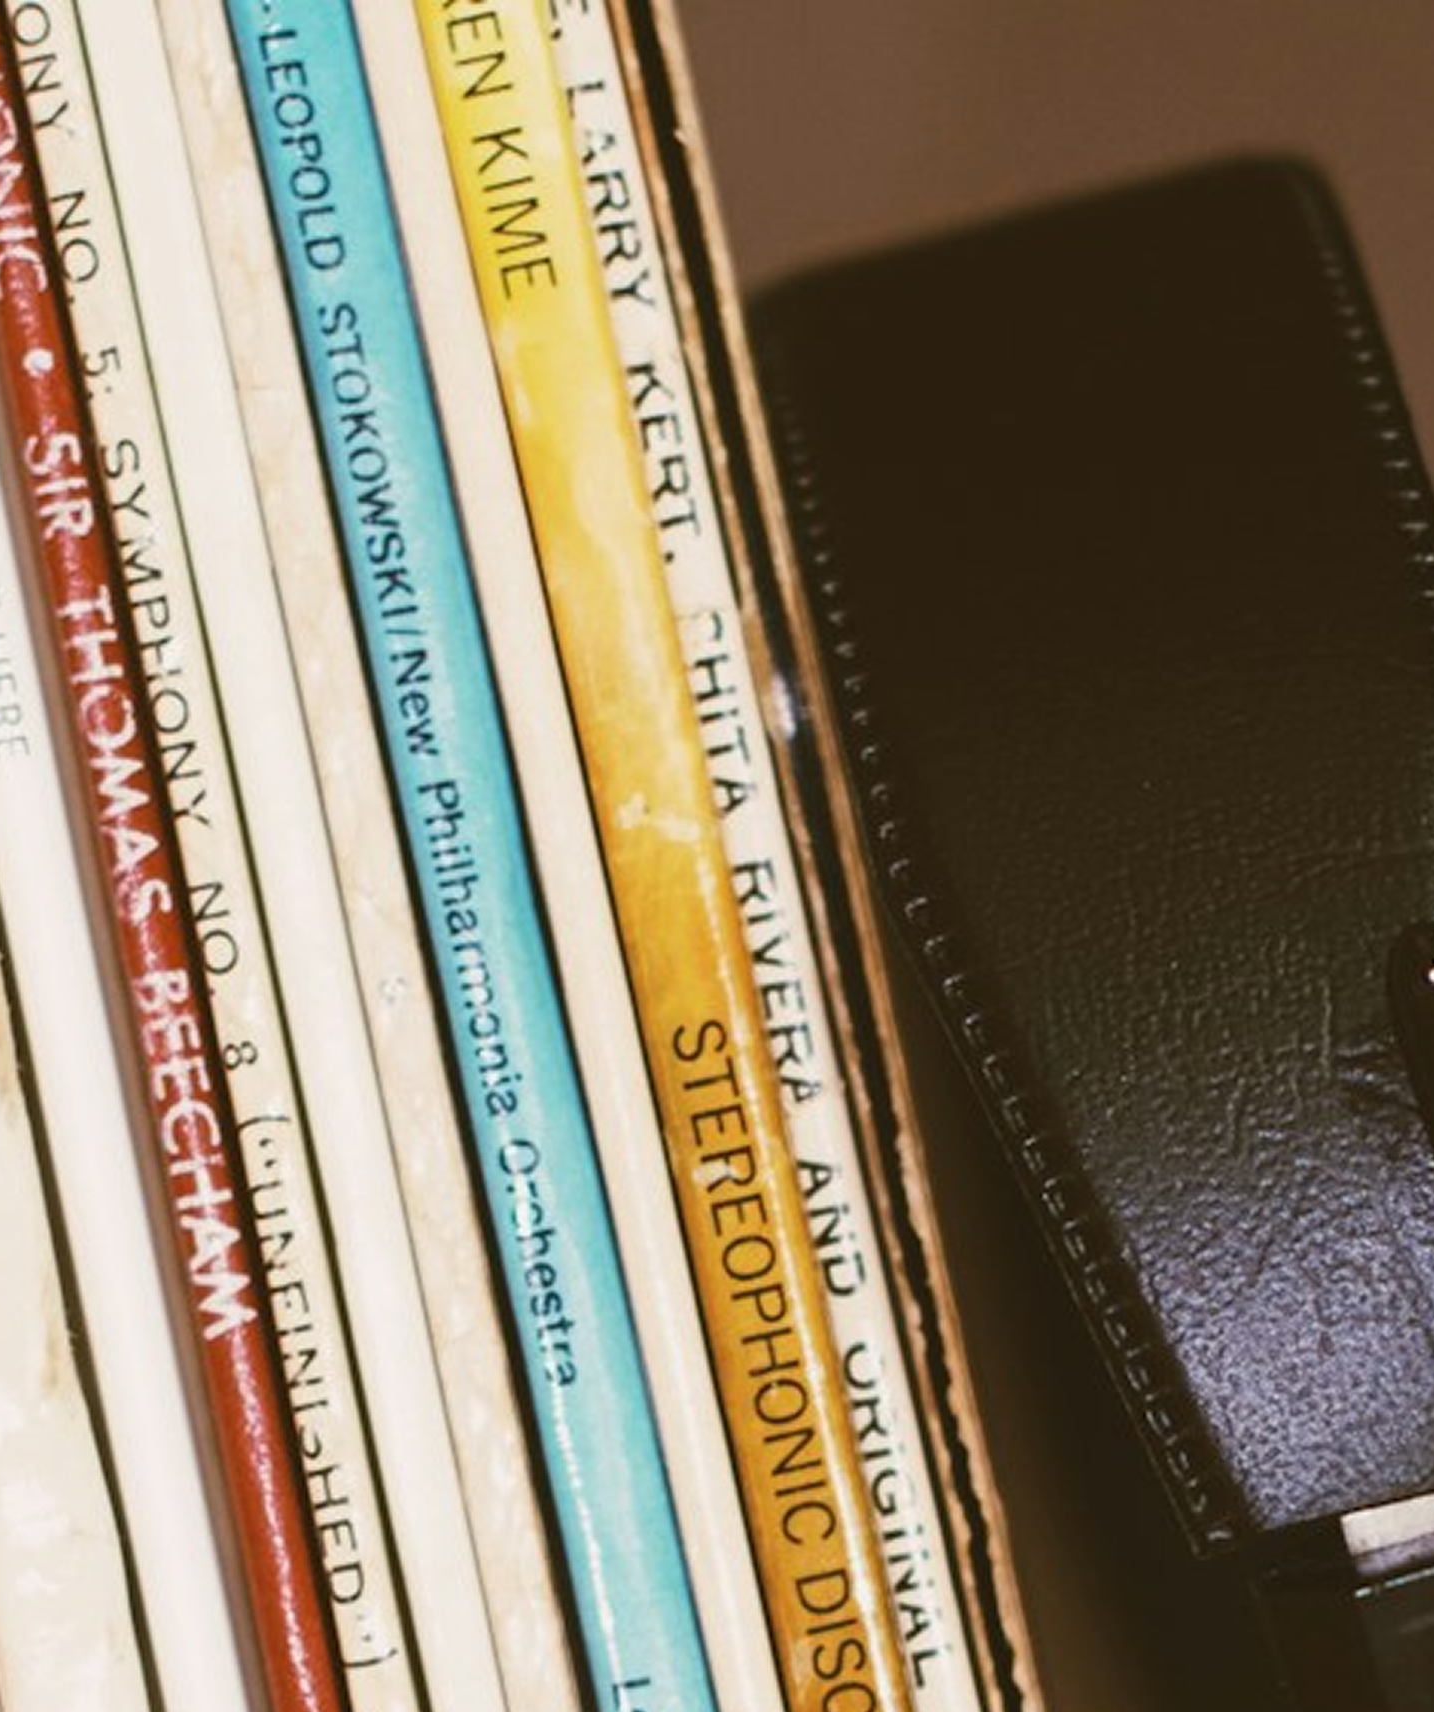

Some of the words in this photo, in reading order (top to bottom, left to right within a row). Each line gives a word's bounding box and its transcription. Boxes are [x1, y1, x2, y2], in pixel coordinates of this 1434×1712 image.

[22, 432, 95, 540] SIR
[49, 189, 100, 307] NO.
[99, 439, 211, 829] SYMPHONY
[186, 882, 239, 1000] NO.
[221, 1041, 258, 1071] 8
[54, 585, 173, 924] THOMAS
[258, 30, 346, 272] LEOPOLD
[415, 779, 520, 1118] Philharmonia
[470, 125, 557, 301] KIME
[671, 1019, 837, 1546] STEREOPHONIC
[563, 80, 656, 309] LARRY
[727, 858, 821, 1107] RIVERA
[794, 1160, 865, 1297] AND
[134, 967, 257, 1340] BEECHAM
